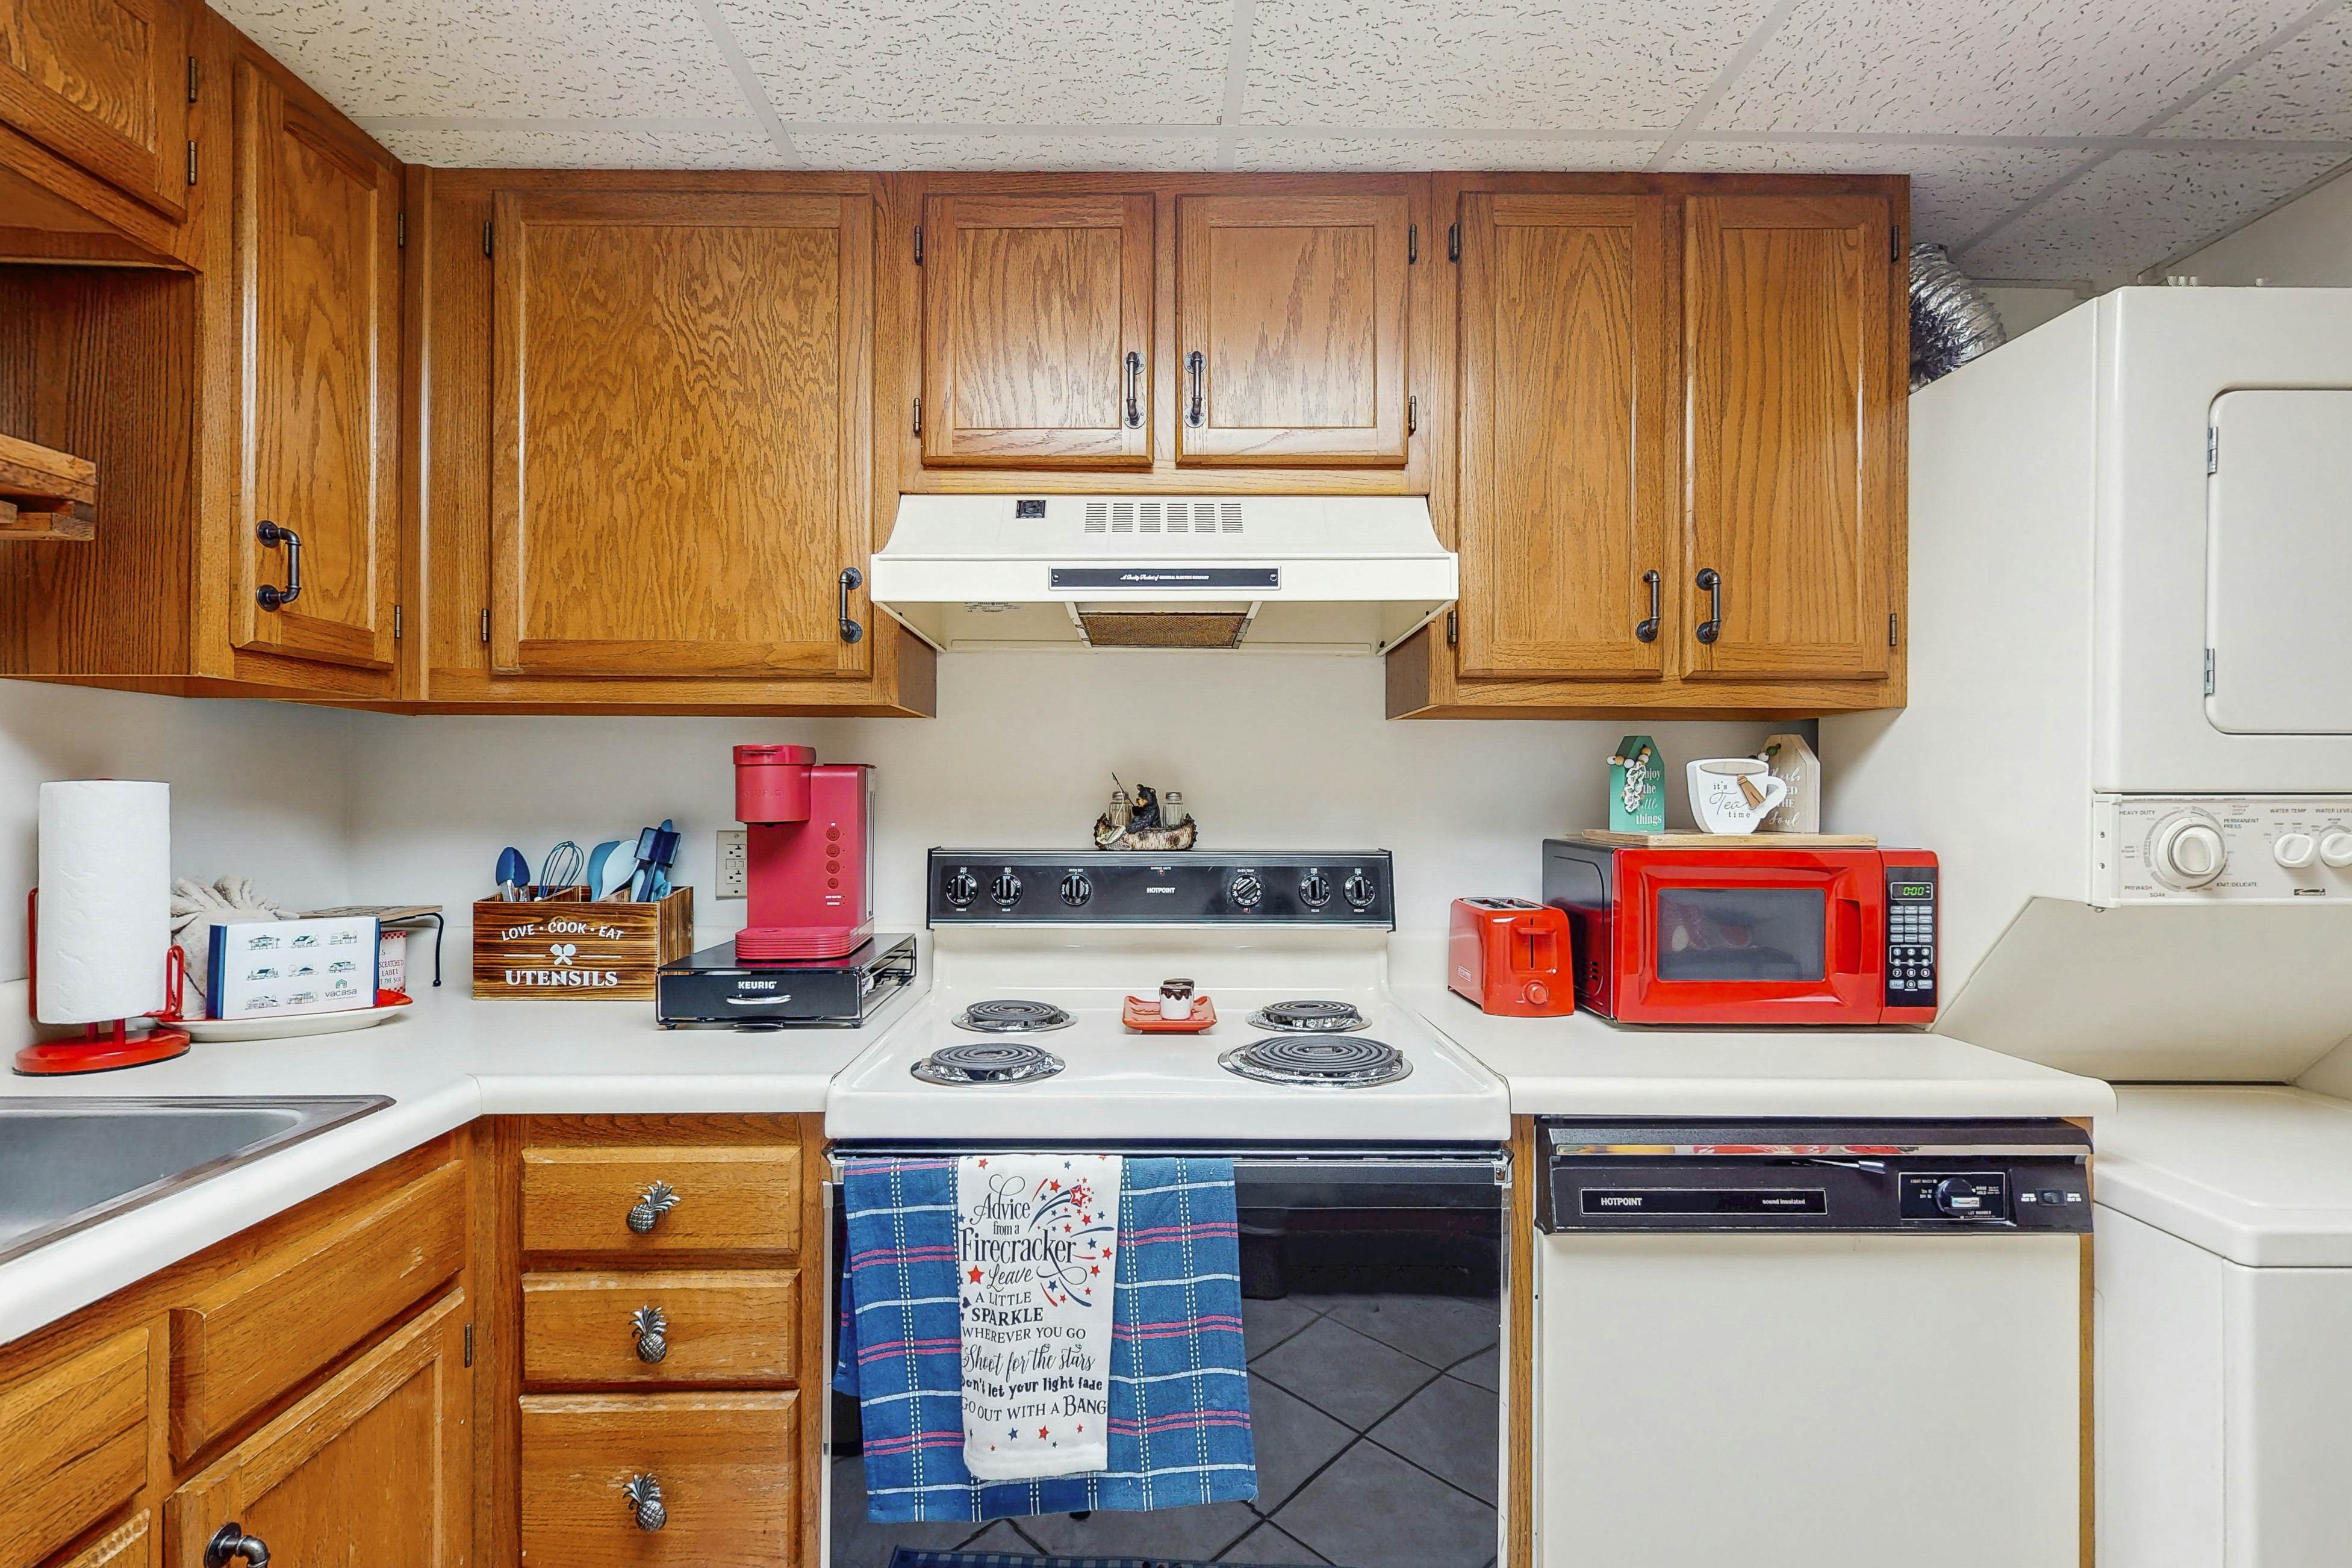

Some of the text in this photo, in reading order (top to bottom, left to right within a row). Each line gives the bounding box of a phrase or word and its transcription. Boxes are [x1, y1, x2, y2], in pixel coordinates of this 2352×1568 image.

[1644, 768, 1660, 780] njoy
[1643, 783, 1656, 794] the
[1713, 781, 1728, 790] it's
[1787, 786, 1798, 795] ED
[1710, 790, 1748, 815] Tea
[1778, 799, 1794, 807] HE
[1636, 814, 1662, 826] things
[1769, 811, 1800, 827] Soul
[1903, 886, 1924, 896] 0:00
[501, 921, 624, 942] LOVE COOK EAT
[382, 968, 398, 977] LABEL
[505, 970, 618, 987] UTENSILS
[325, 988, 356, 997] vacasa
[970, 1174, 1030, 1225] Advice
[1601, 1197, 1643, 1206] HOTPOINT
[994, 1221, 1019, 1235] from a
[959, 1227, 1087, 1285] Firecracker
[986, 1264, 1033, 1292] Leave
[975, 1292, 1031, 1307] A LITTLE
[972, 1307, 1044, 1326] SPARKLE
[963, 1327, 1086, 1343] WHEREVER YOU GO
[962, 1343, 1096, 1383] Shoot for the stars
[988, 1383, 1004, 1398] let
[1009, 1381, 1039, 1400] your
[1042, 1376, 1074, 1392] light
[1078, 1377, 1103, 1391] fade
[962, 1395, 1107, 1422] GO OUT WITH A BANG
